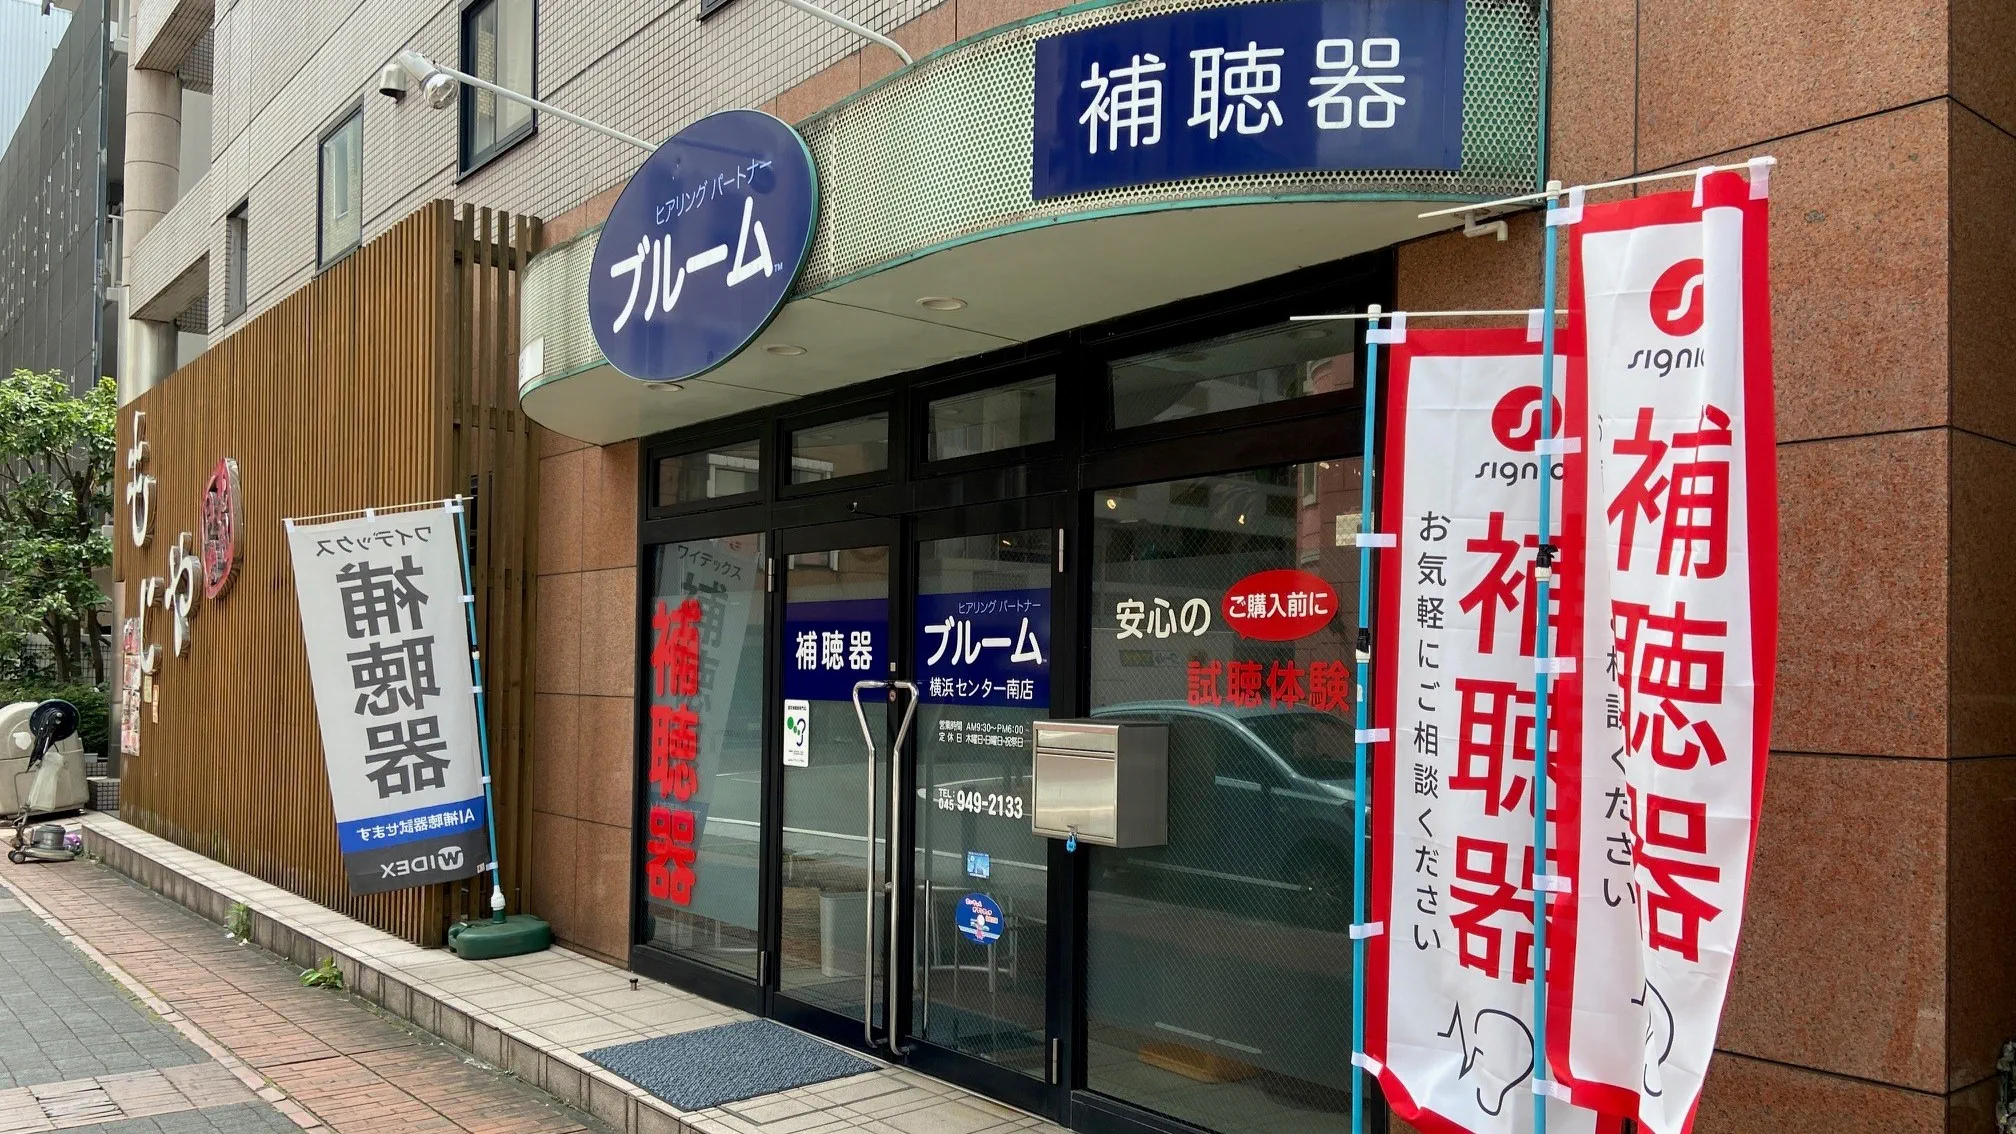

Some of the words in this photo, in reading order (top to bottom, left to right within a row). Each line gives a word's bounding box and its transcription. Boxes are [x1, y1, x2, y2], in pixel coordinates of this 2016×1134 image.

[1079, 37, 1407, 154] 補聴器
[656, 181, 707, 225] ヒアリング
[711, 158, 772, 200] パートナー
[610, 196, 773, 333] ブルーム
[1475, 461, 1563, 487] signa
[1115, 598, 1211, 640] 安心の
[1229, 591, 1329, 619] ご購入前に
[795, 630, 873, 671] 補聴器
[924, 616, 1042, 666] ブルーム
[929, 677, 1034, 700] 横浜センター南店
[1186, 658, 1351, 712] 試聴体験
[647, 598, 702, 906] 補聴器
[1413, 510, 1452, 951] お気軽にご相談ください
[957, 790, 1023, 819] 949-2133
